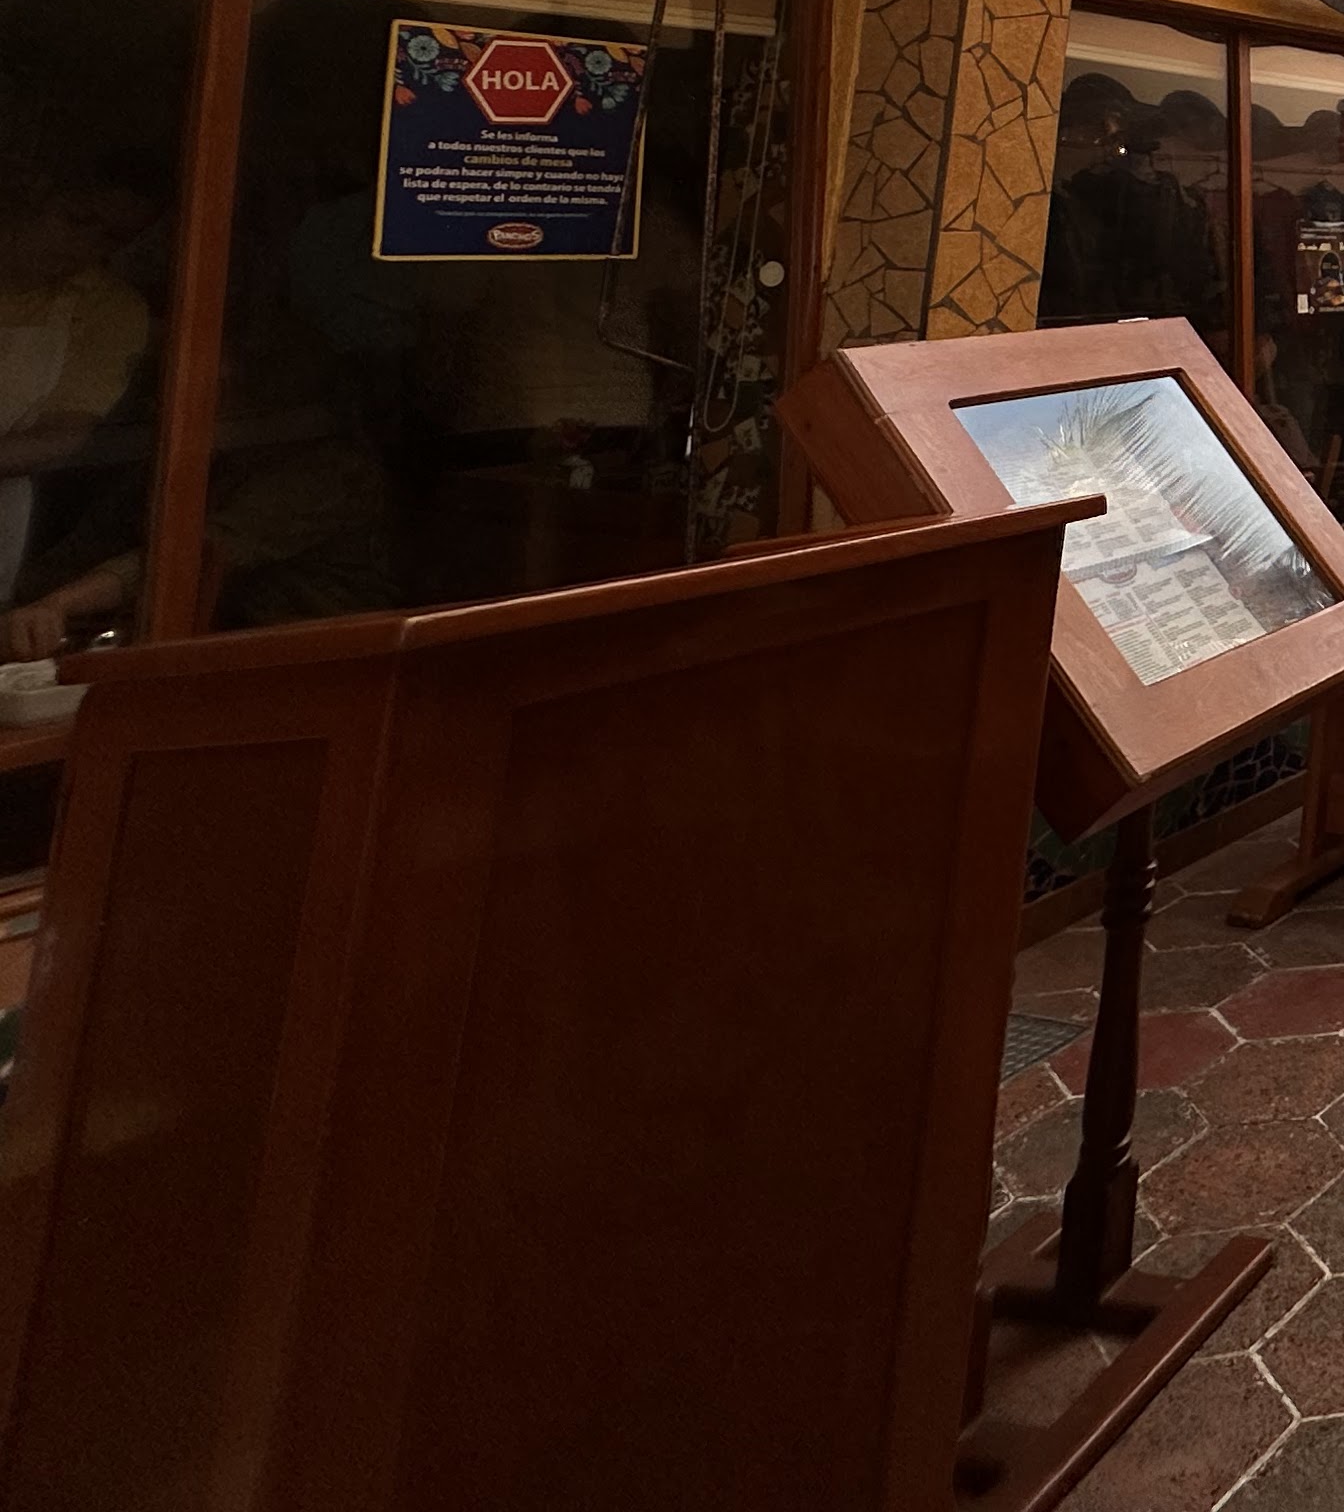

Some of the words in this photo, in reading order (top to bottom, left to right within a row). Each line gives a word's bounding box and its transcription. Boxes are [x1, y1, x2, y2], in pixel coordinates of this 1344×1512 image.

[481, 70, 560, 92] HOLA
[481, 129, 494, 139] Se
[497, 130, 513, 140] les
[515, 131, 558, 142] informa
[428, 141, 435, 149] a
[438, 140, 472, 151] todos
[474, 143, 523, 154] nuestros
[525, 145, 566, 156] clientes
[568, 147, 588, 157] que
[589, 147, 605, 157] los
[464, 154, 519, 166] cambios
[520, 156, 537, 166] de
[540, 159, 573, 167] mesa
[399, 166, 413, 175] se
[461, 168, 492, 178] hacer
[536, 171, 542, 181] y
[544, 170, 584, 180] cuando
[432, 179, 447, 189] de
[449, 181, 491, 192] espera,
[493, 180, 509, 190] de
[510, 181, 521, 191] lo
[523, 181, 572, 192] contrario
[574, 184, 586, 193] se
[417, 193, 441, 204] que
[443, 193, 492, 204] respetar
[493, 193, 505, 202] el
[508, 195, 543, 204] orden
[544, 195, 558, 204] de
[559, 195, 569, 204] la
